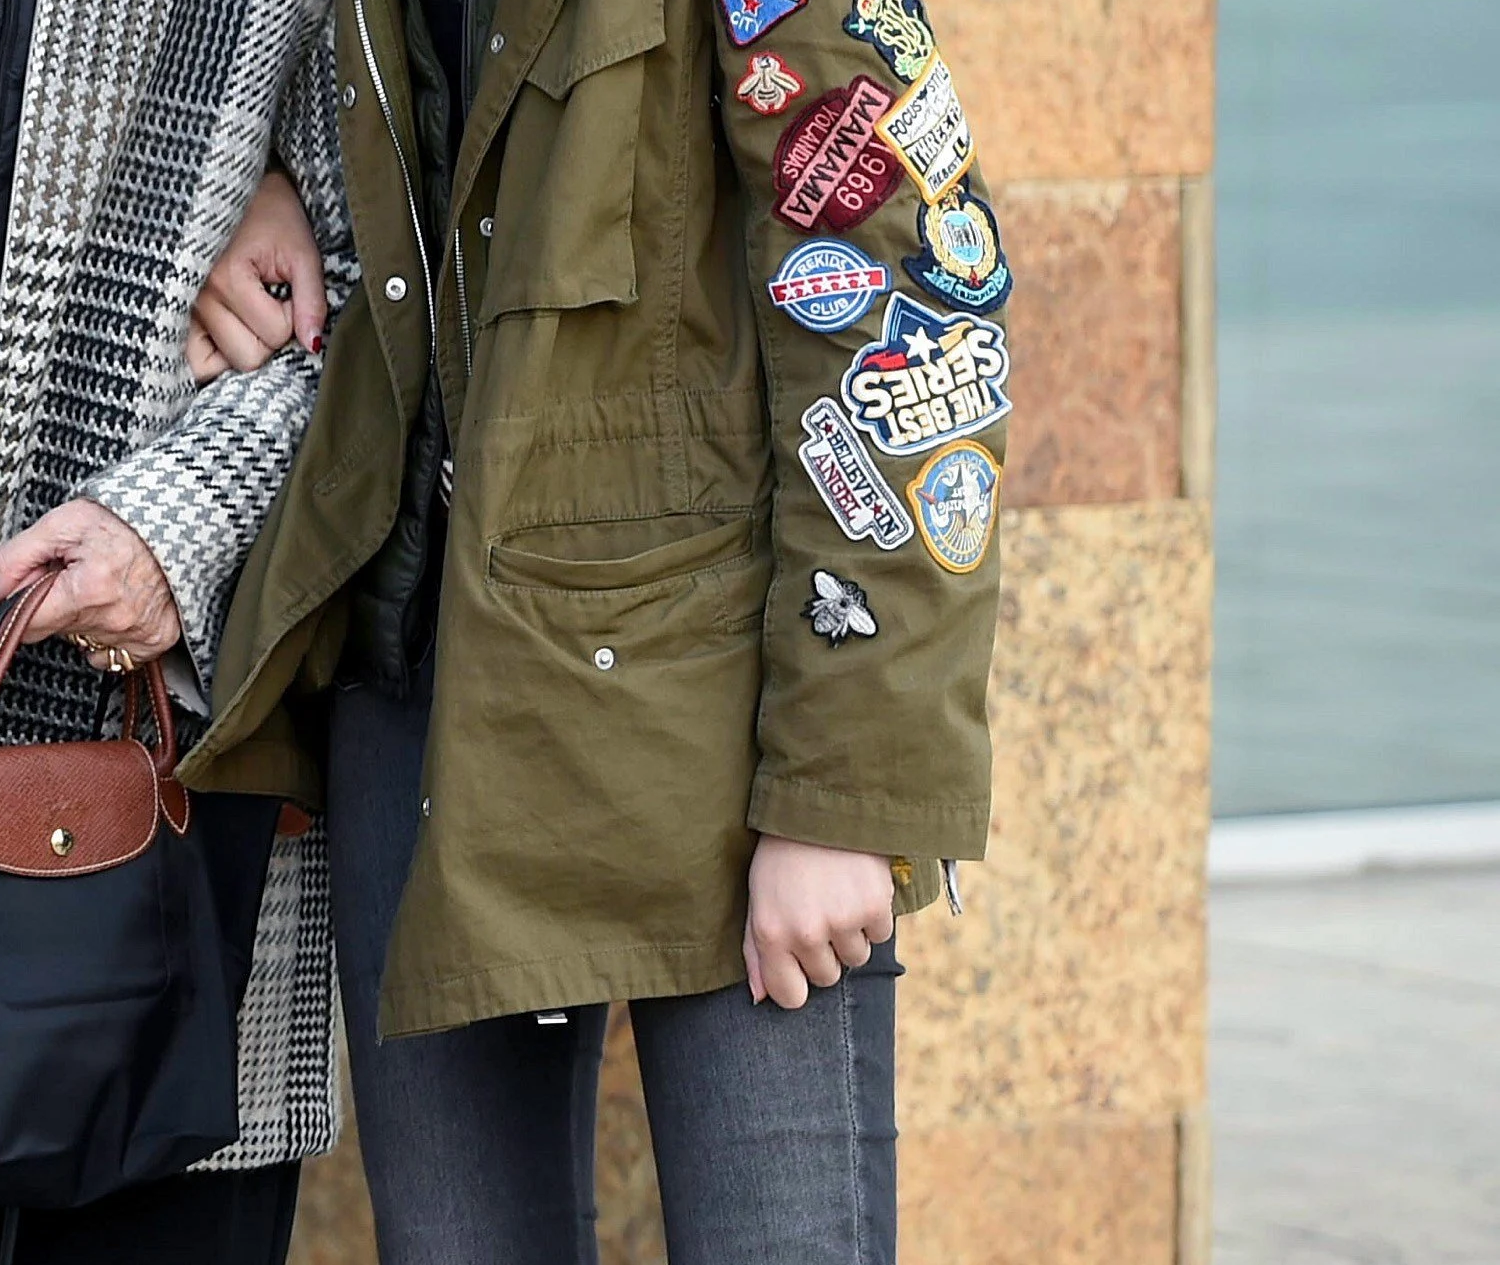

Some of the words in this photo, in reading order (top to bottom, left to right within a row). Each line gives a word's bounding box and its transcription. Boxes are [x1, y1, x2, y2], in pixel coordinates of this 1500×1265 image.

[730, 11, 762, 34] CITY
[887, 100, 922, 145] FOCUS
[810, 297, 849, 315] CLUB
[851, 329, 1002, 419] SERIES
[887, 395, 953, 446] BEST
[953, 380, 996, 429] THE
[814, 452, 861, 521] ANGEL
[827, 426, 880, 509] BELIEVE
[874, 507, 901, 536] IN
